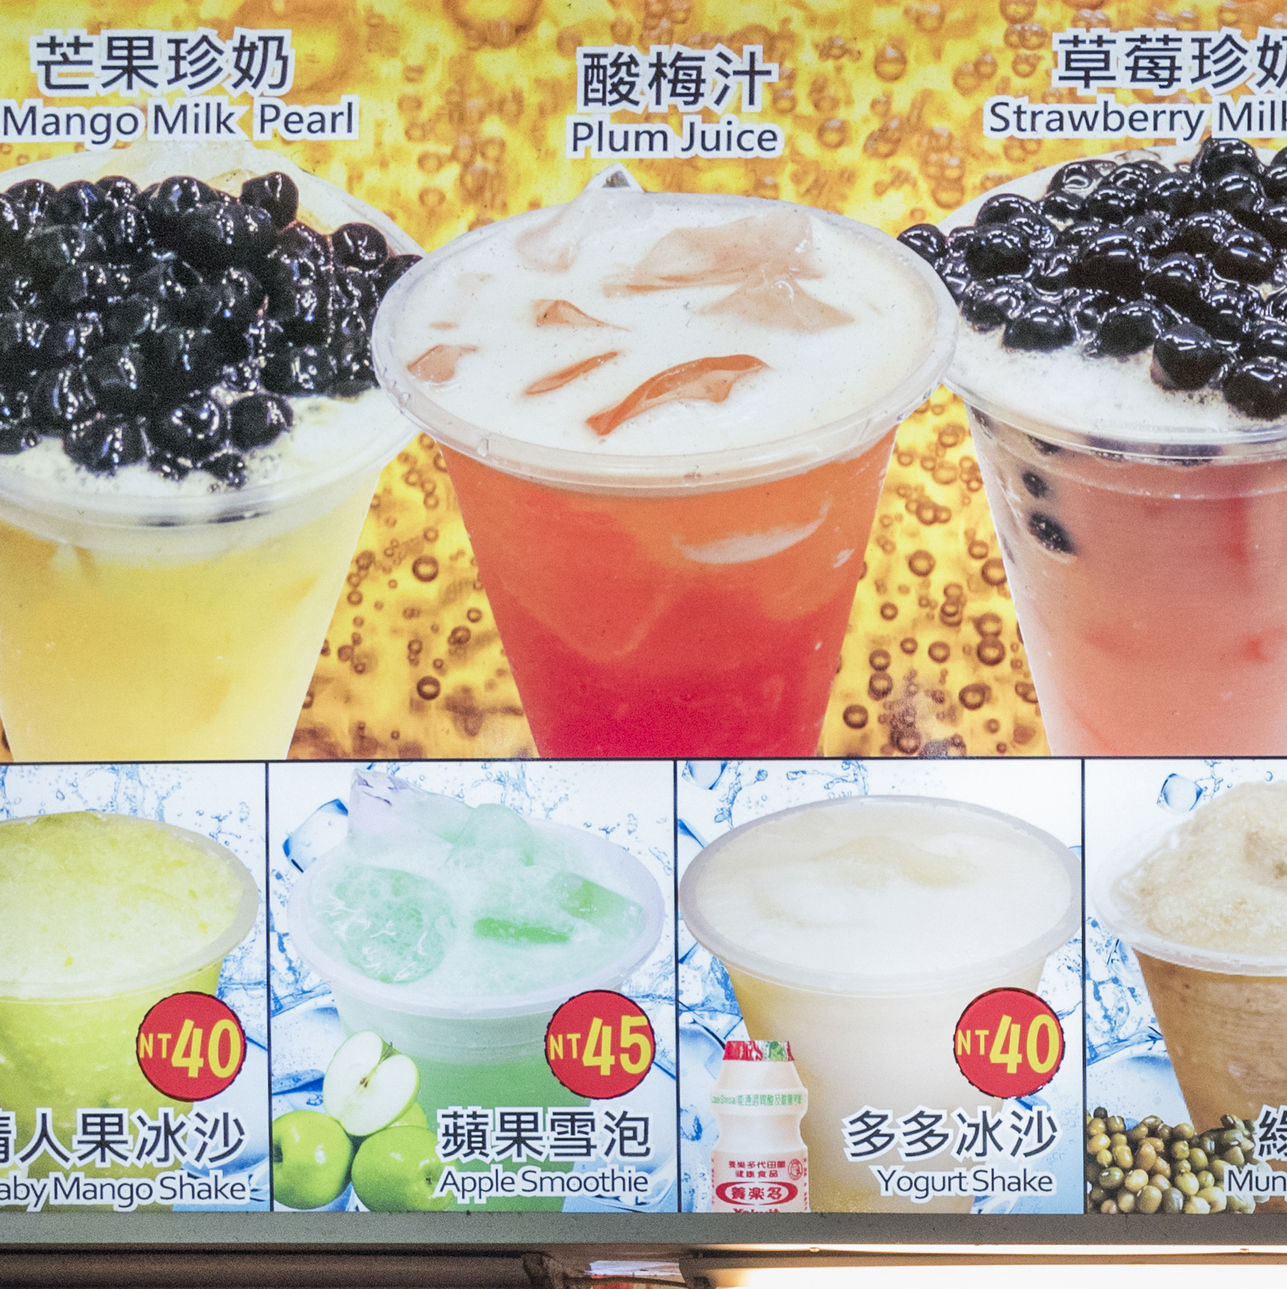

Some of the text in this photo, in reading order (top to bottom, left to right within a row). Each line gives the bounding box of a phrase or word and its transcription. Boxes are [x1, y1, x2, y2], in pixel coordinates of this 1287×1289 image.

[35, 34, 292, 93] 芒果珍奶
[584, 50, 764, 108] 酸梅汁
[2, 103, 354, 146] Mango Milk Pearl
[573, 121, 777, 153] Plum Juice
[990, 100, 1205, 141] Strawberry
[440, 1110, 652, 1160] 蘋果雪泡
[847, 1108, 1059, 1159] 多多冰沙
[440, 1168, 648, 1200] Apple Smoothie
[877, 1168, 1053, 1199] Yogurt Shake
